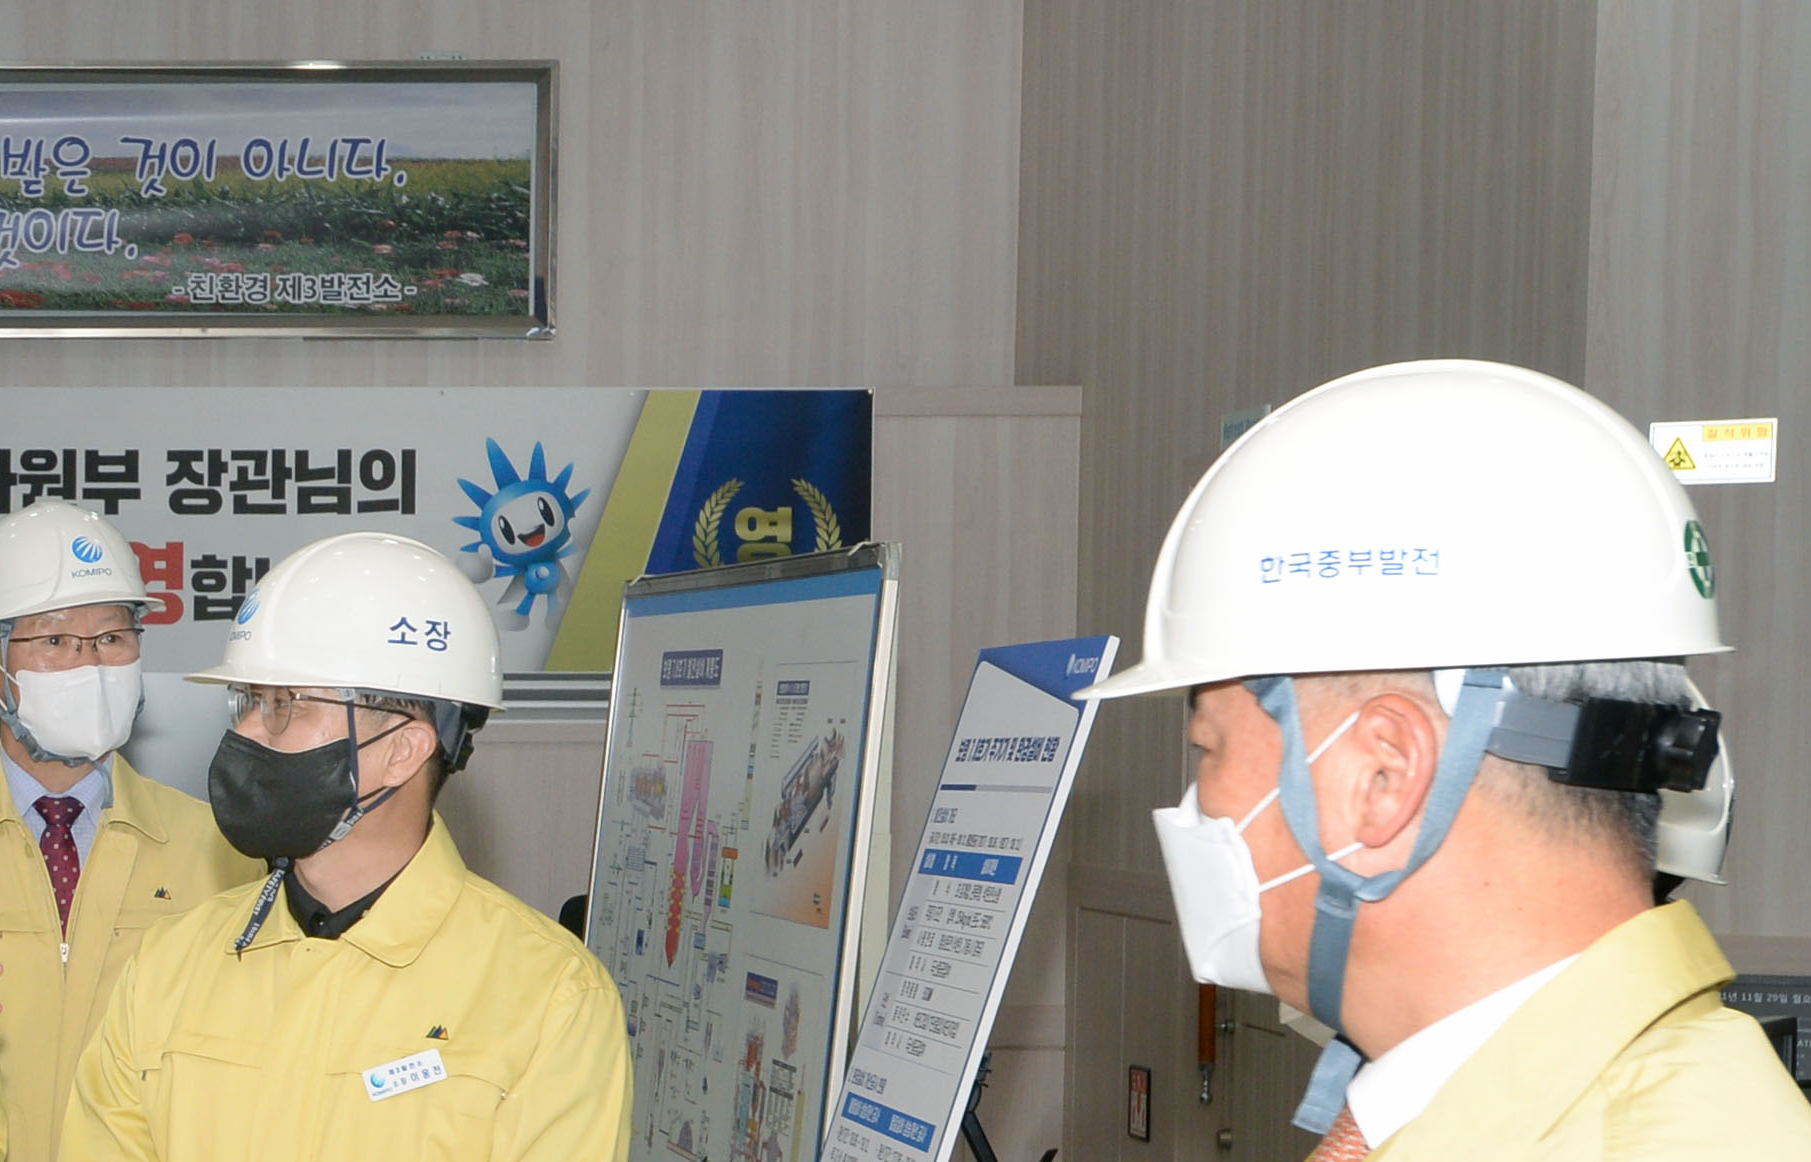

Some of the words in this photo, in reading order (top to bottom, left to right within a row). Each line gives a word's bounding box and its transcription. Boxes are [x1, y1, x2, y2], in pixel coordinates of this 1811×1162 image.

[119, 136, 218, 198] 것이
[241, 136, 408, 187] 아니다.
[164, 447, 418, 516] 장관님의
[71, 567, 113, 579] KOMIPO
[1258, 547, 1441, 584] 한국중부발전
[388, 615, 451, 652] 소장
